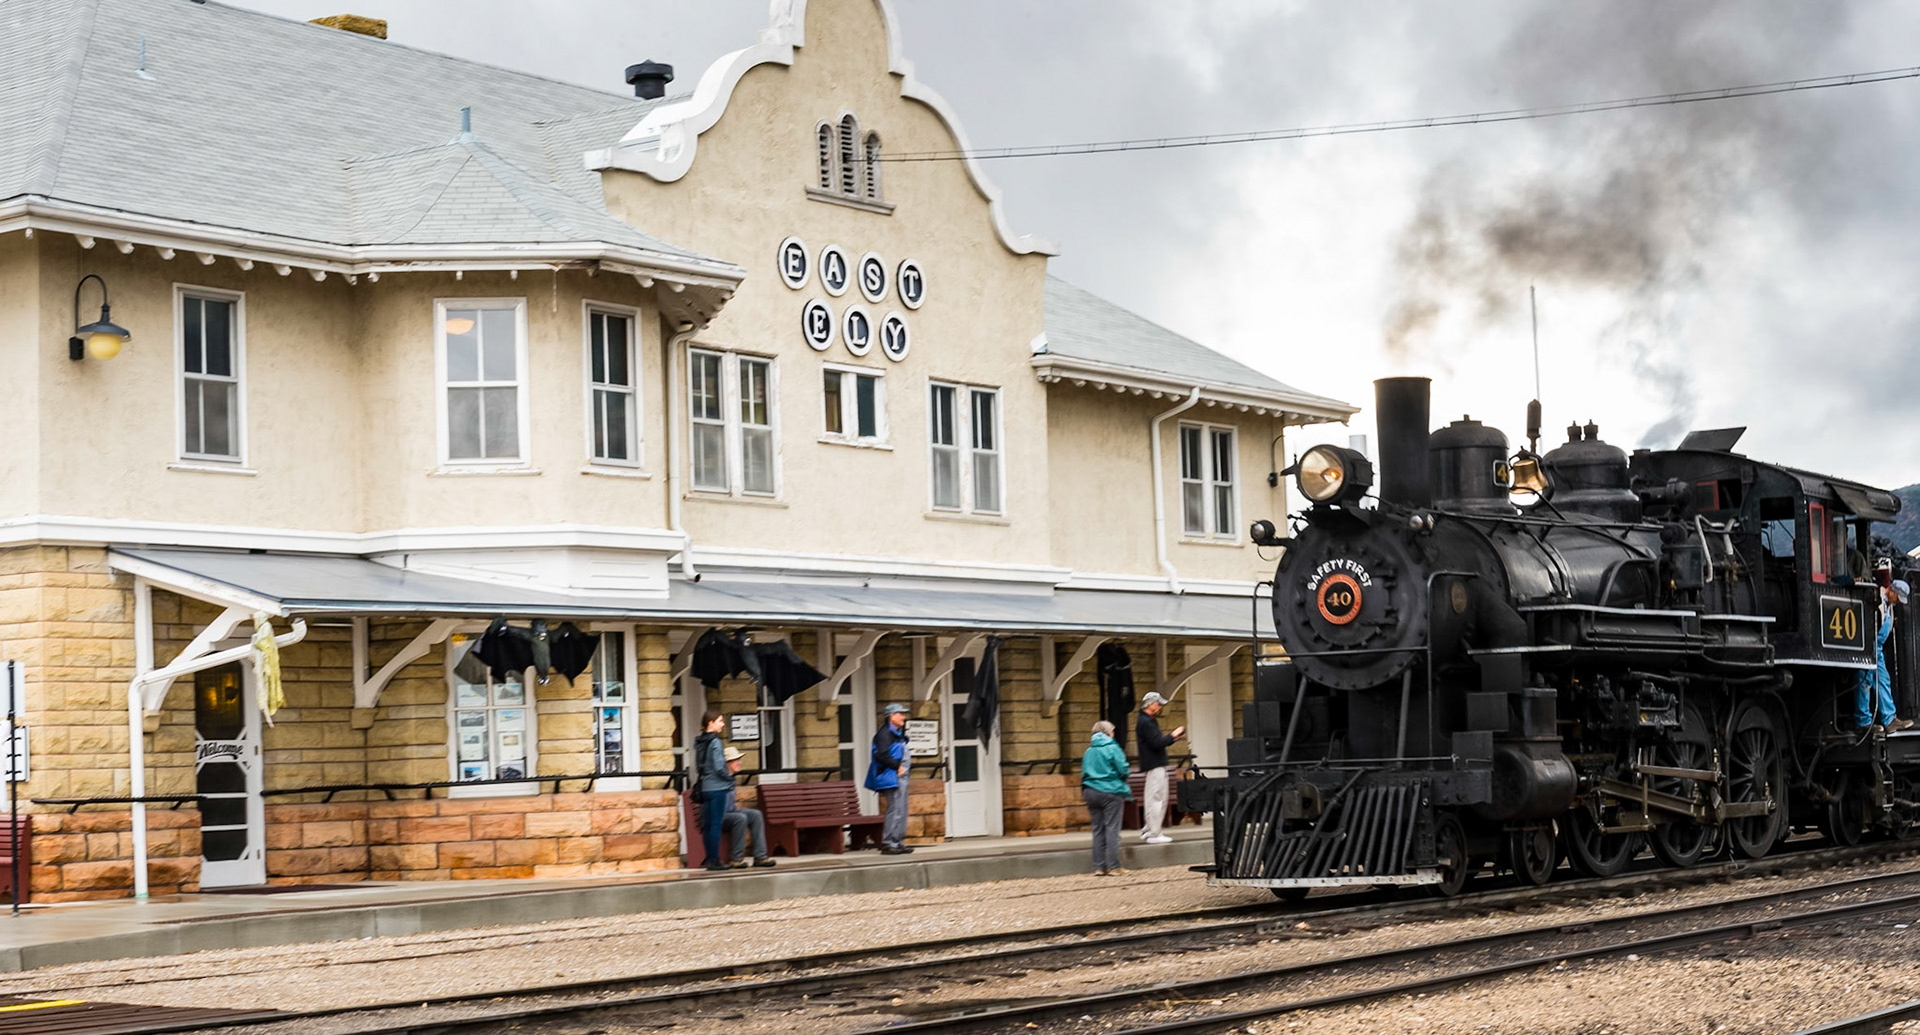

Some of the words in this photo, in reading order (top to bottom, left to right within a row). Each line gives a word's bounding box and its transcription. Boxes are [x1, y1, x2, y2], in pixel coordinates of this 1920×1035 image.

[787, 248, 919, 297] EAST
[812, 309, 904, 349] ELY
[1307, 558, 1344, 590] SAFETY
[1346, 560, 1372, 587] FIRST
[1327, 592, 1352, 606] 40
[1829, 608, 1857, 640] 40
[196, 742, 243, 759] Welcome
